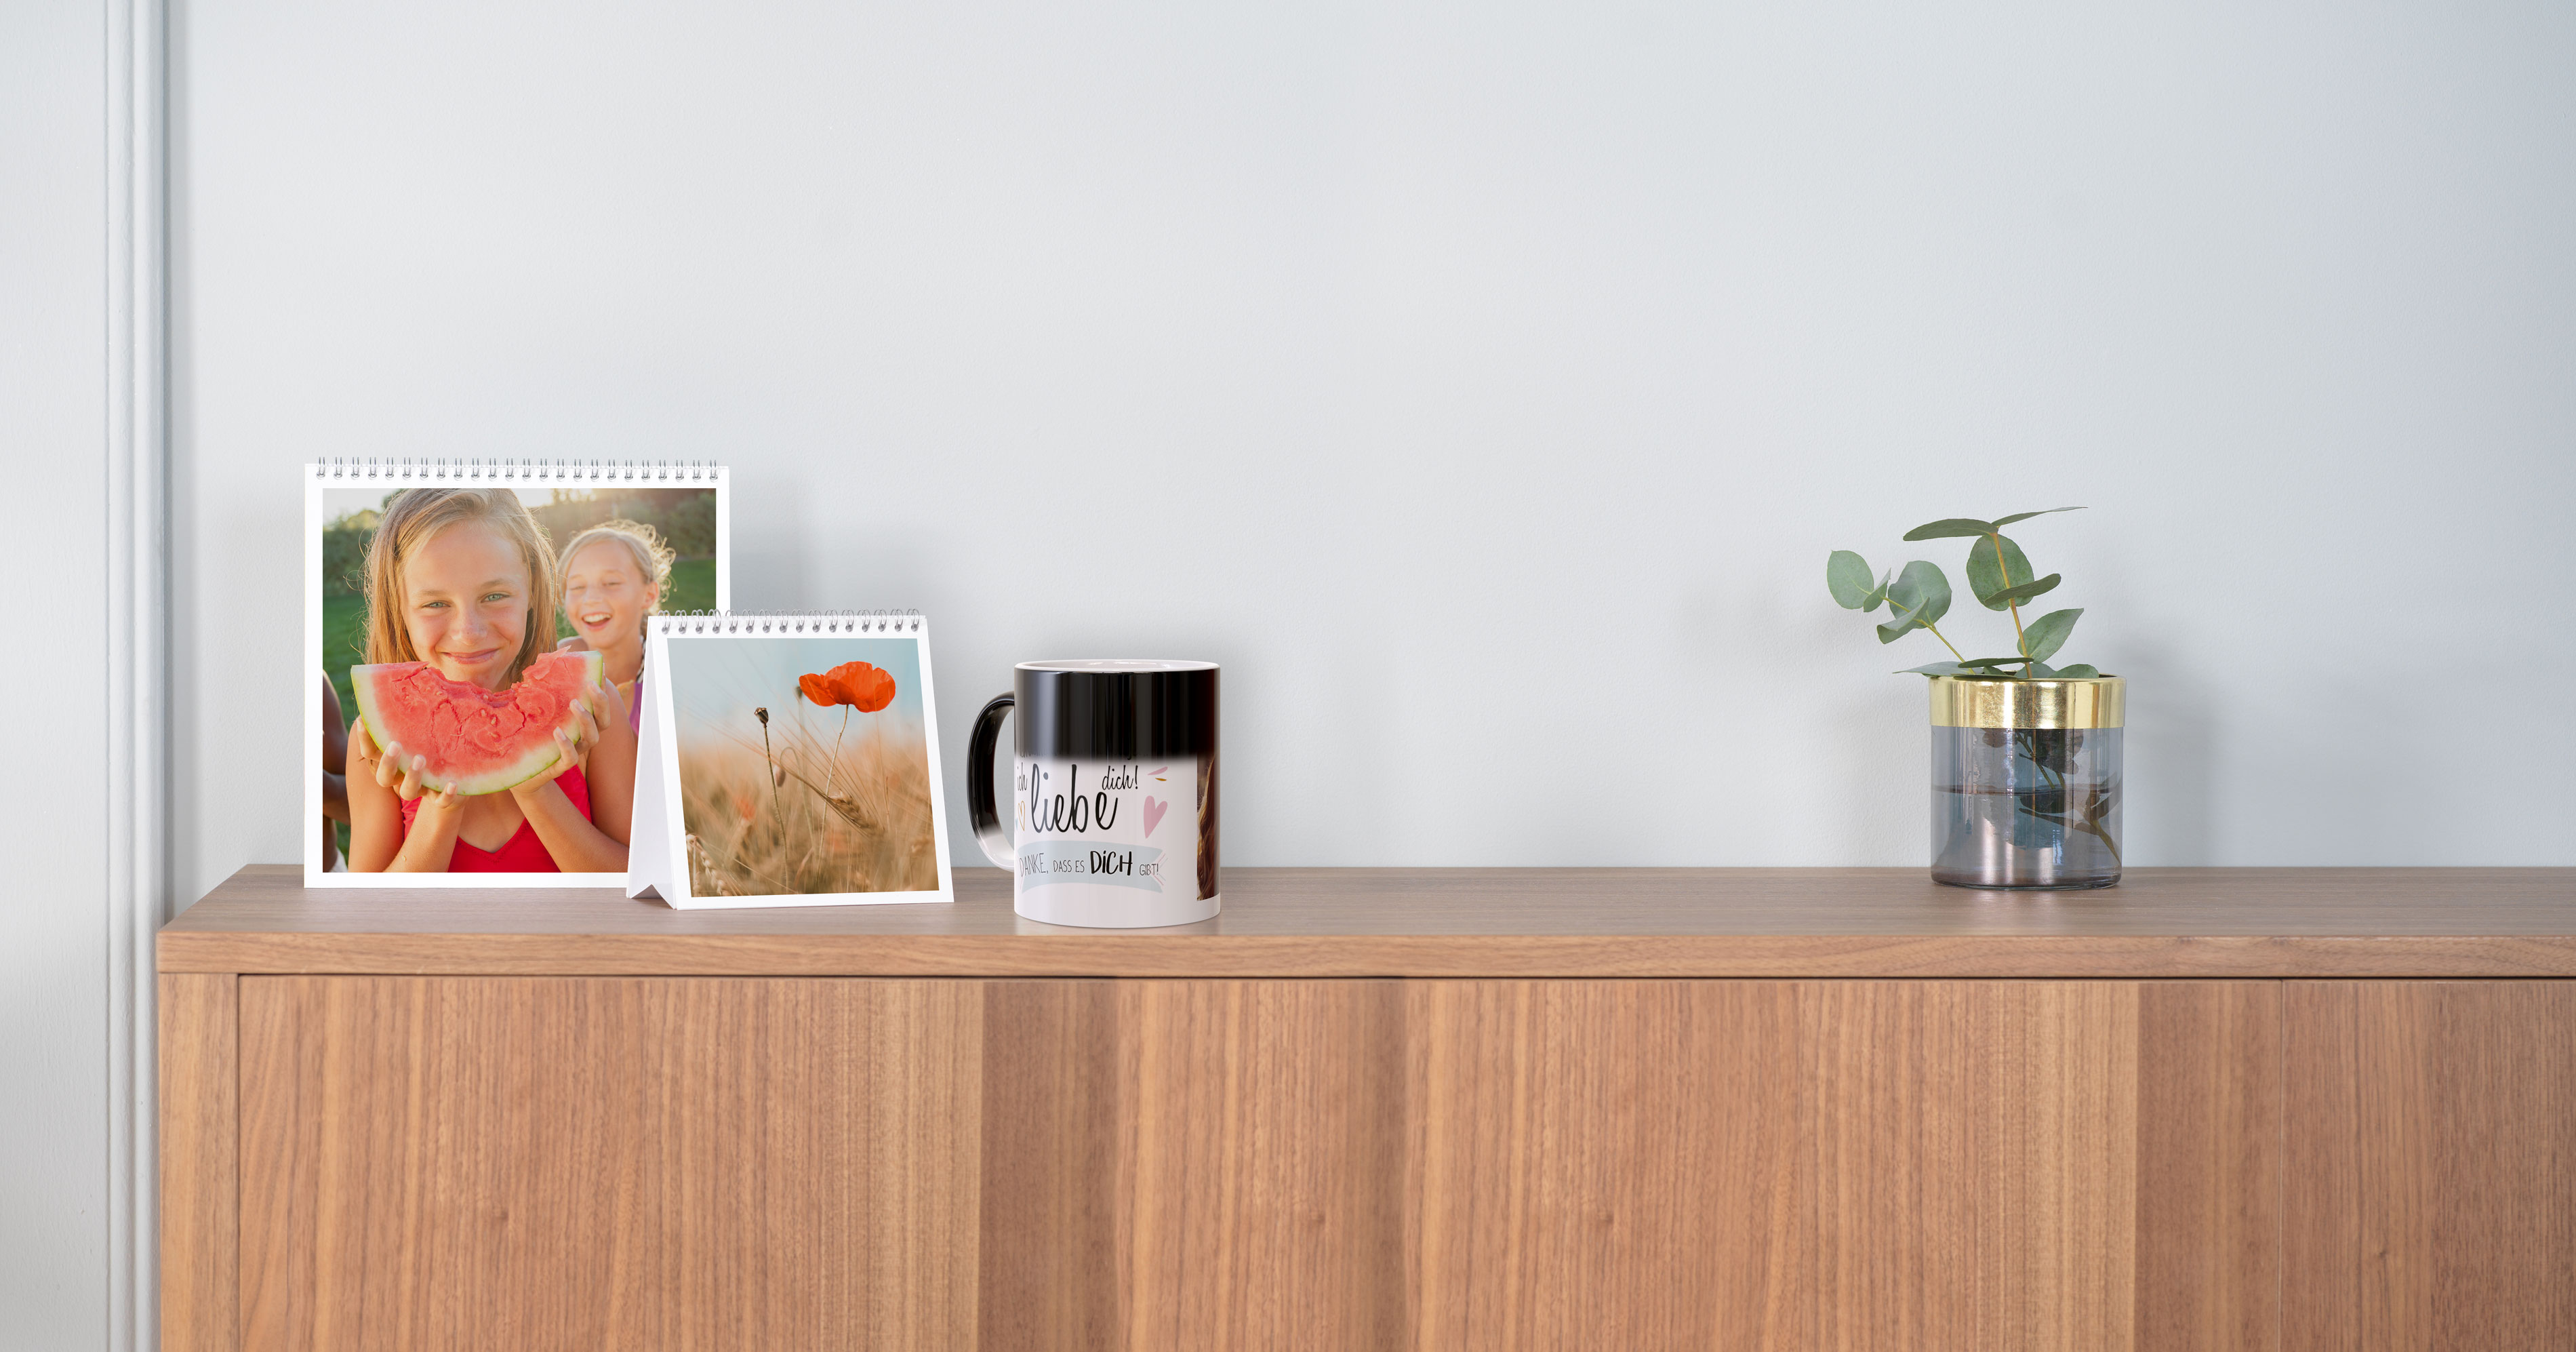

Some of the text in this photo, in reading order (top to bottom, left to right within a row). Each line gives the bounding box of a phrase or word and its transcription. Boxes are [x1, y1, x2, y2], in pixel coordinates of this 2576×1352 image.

[1017, 761, 1139, 834] ich liebe dich!
[1019, 852, 1049, 877] DANKE,
[1053, 859, 1072, 873] DASS
[1075, 860, 1085, 873] ES
[1139, 863, 1159, 876] GIBT!
